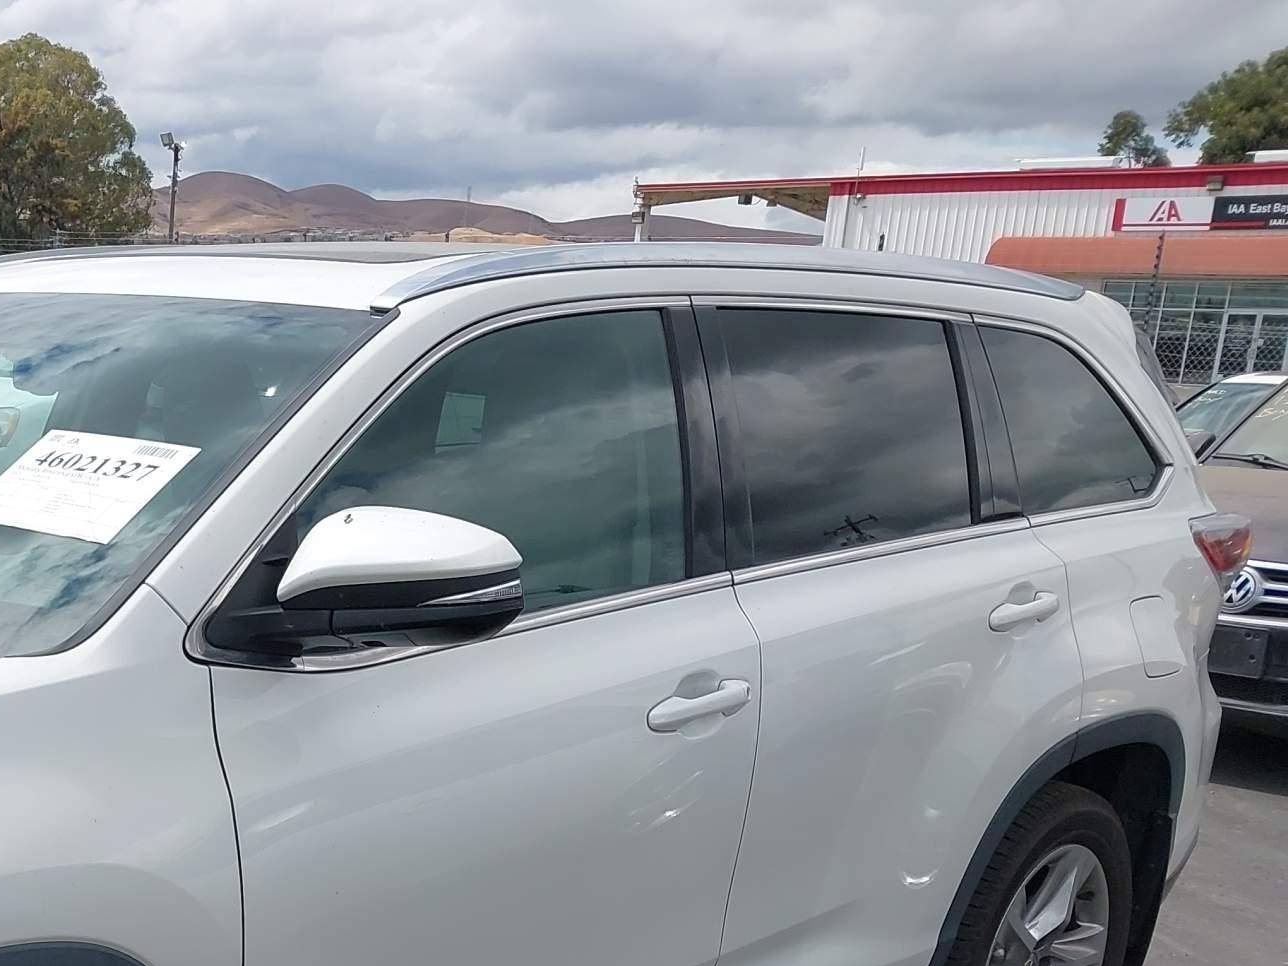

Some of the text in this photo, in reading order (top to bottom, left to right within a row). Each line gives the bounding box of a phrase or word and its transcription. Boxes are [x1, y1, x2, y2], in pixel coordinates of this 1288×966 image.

[1227, 203, 1246, 214] IAA
[1249, 202, 1272, 214] East
[35, 450, 160, 482] 46021327
